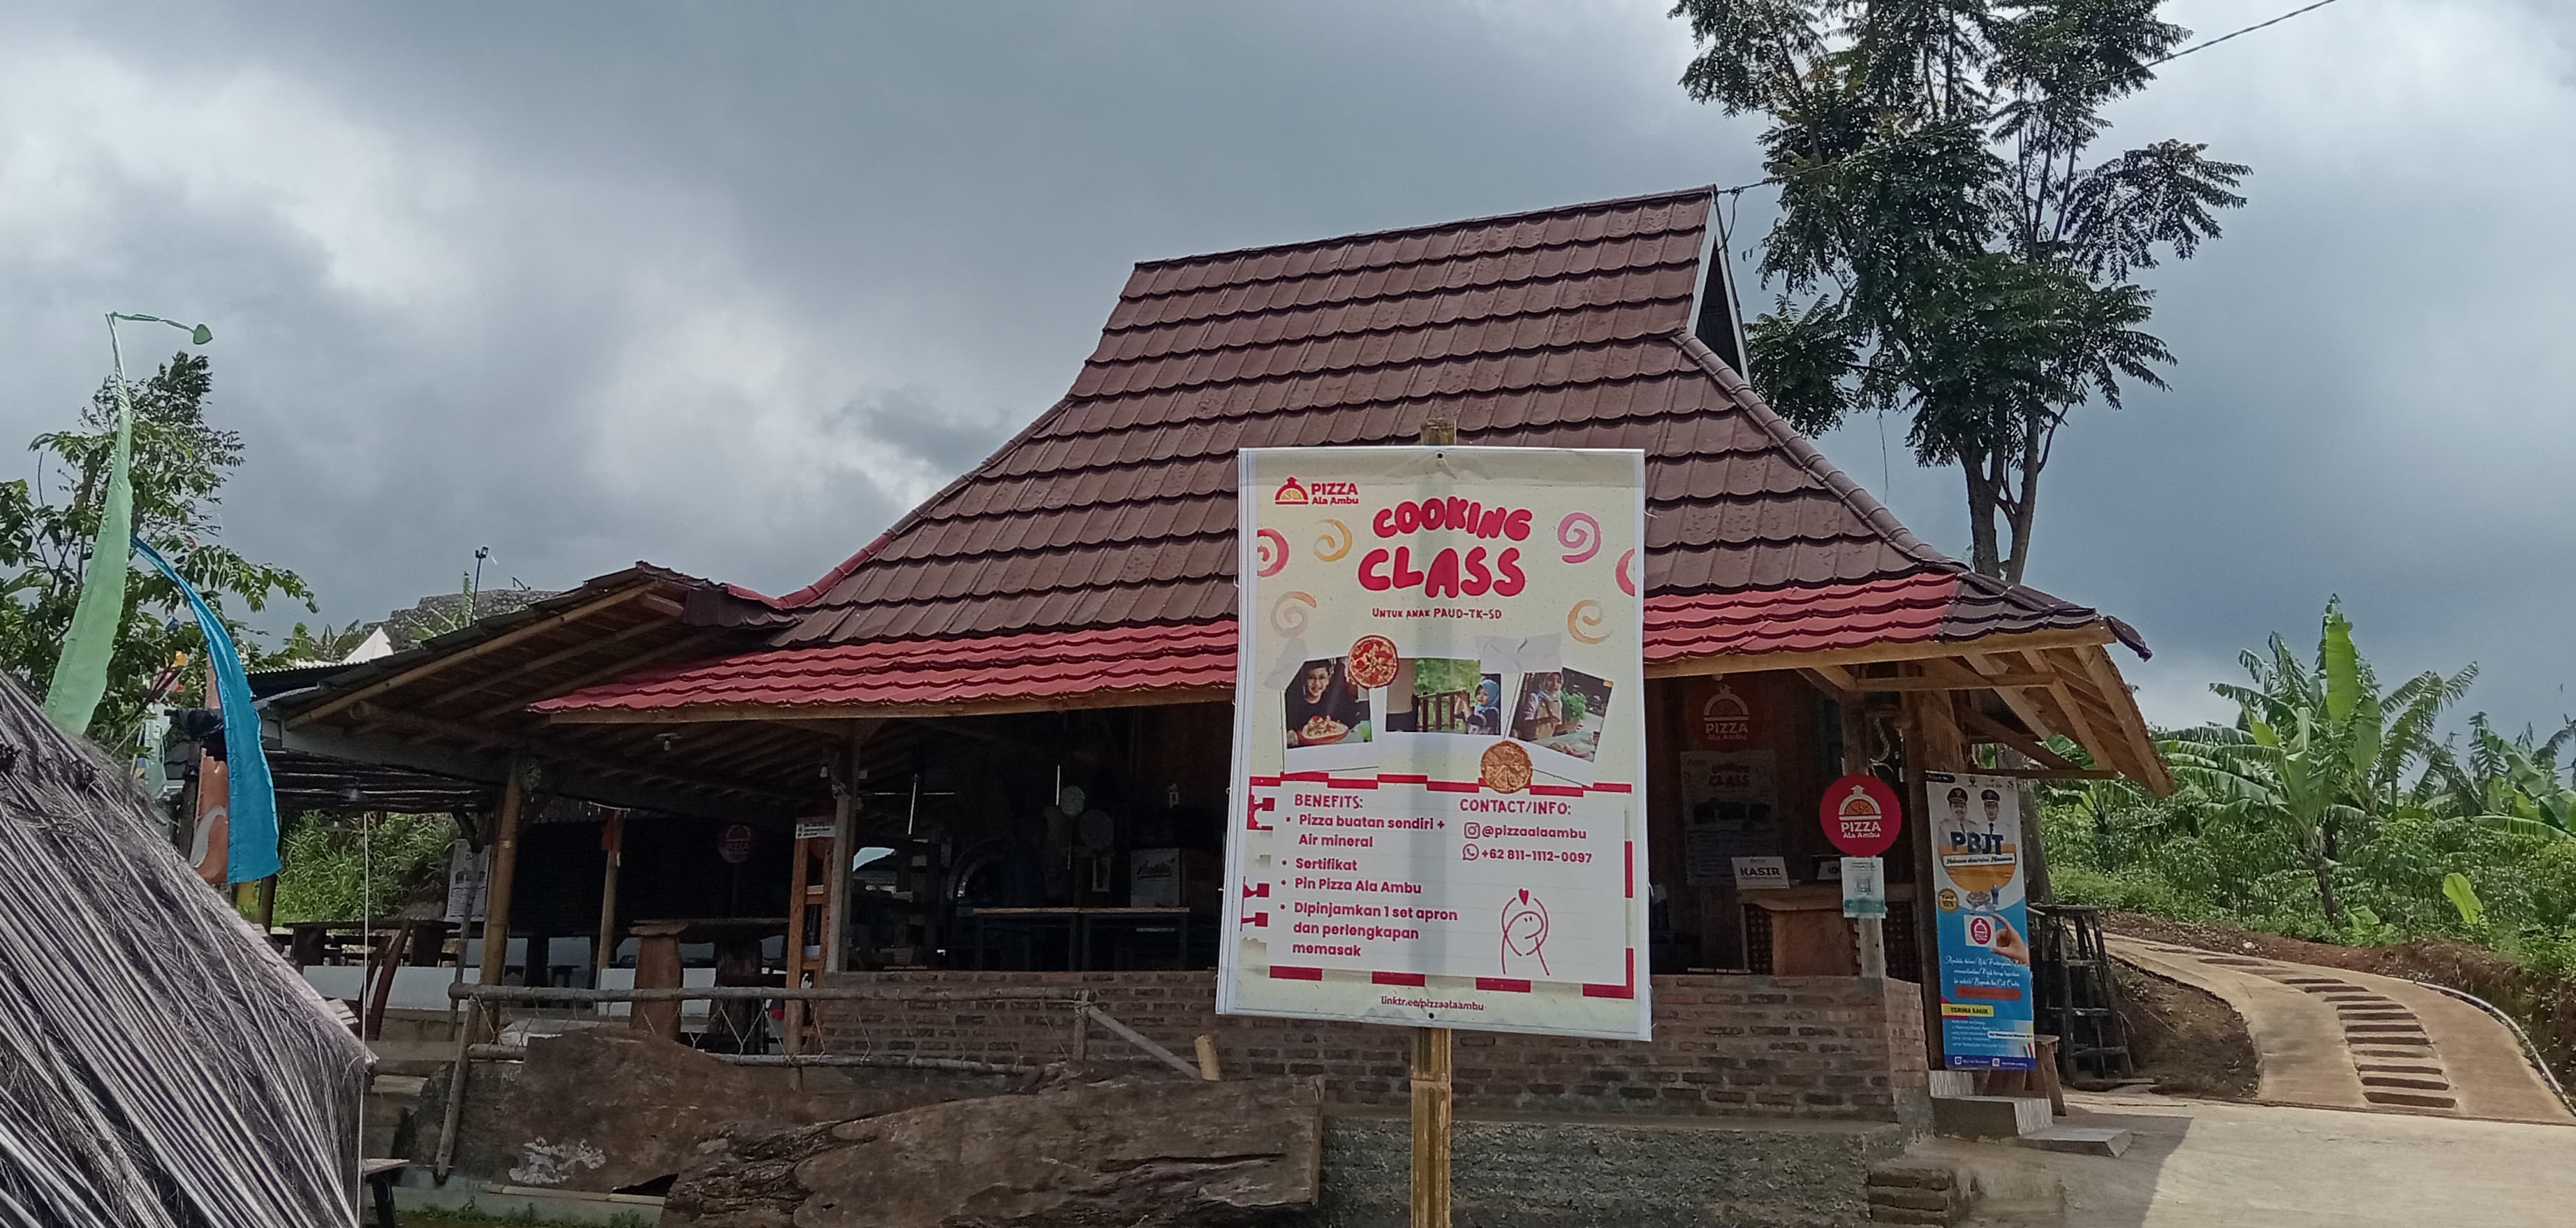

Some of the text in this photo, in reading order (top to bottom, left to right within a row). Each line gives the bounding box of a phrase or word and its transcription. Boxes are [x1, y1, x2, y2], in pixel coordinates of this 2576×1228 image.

[1311, 483, 1358, 495] PIZZA
[1330, 497, 1359, 505] Ambu
[1373, 496, 1533, 541] COOKING
[1358, 546, 1526, 599] CLASS
[1434, 608, 1502, 620] PAUD-TK-SD
[1705, 722, 1749, 733] PIZZA
[1294, 794, 1363, 809] BENEFITS:
[1459, 798, 1571, 815] CONTACT/INFO:
[1299, 814, 1333, 827] Pizza
[1337, 815, 1384, 828] buatan
[1388, 817, 1434, 829] sendiri
[1841, 821, 1881, 832] PIZZA
[1482, 825, 1587, 839] @pizzaalaambu
[1298, 833, 1373, 847] Air mineral
[1950, 831, 2004, 855] PBJT
[1481, 849, 1592, 863] +62 811-1112-0097
[1295, 857, 1357, 871] Sertifikat
[1740, 867, 1780, 876] KASIR
[1295, 877, 1422, 894] Pin Pizza Ala Ambu
[1294, 902, 1458, 923] Dipinjamkan 1 set apron
[1293, 922, 1419, 942] dan perlengkapan
[1293, 944, 1361, 957] memasak
[1381, 996, 1485, 1011] linktr.ee/pizzaalaambu
